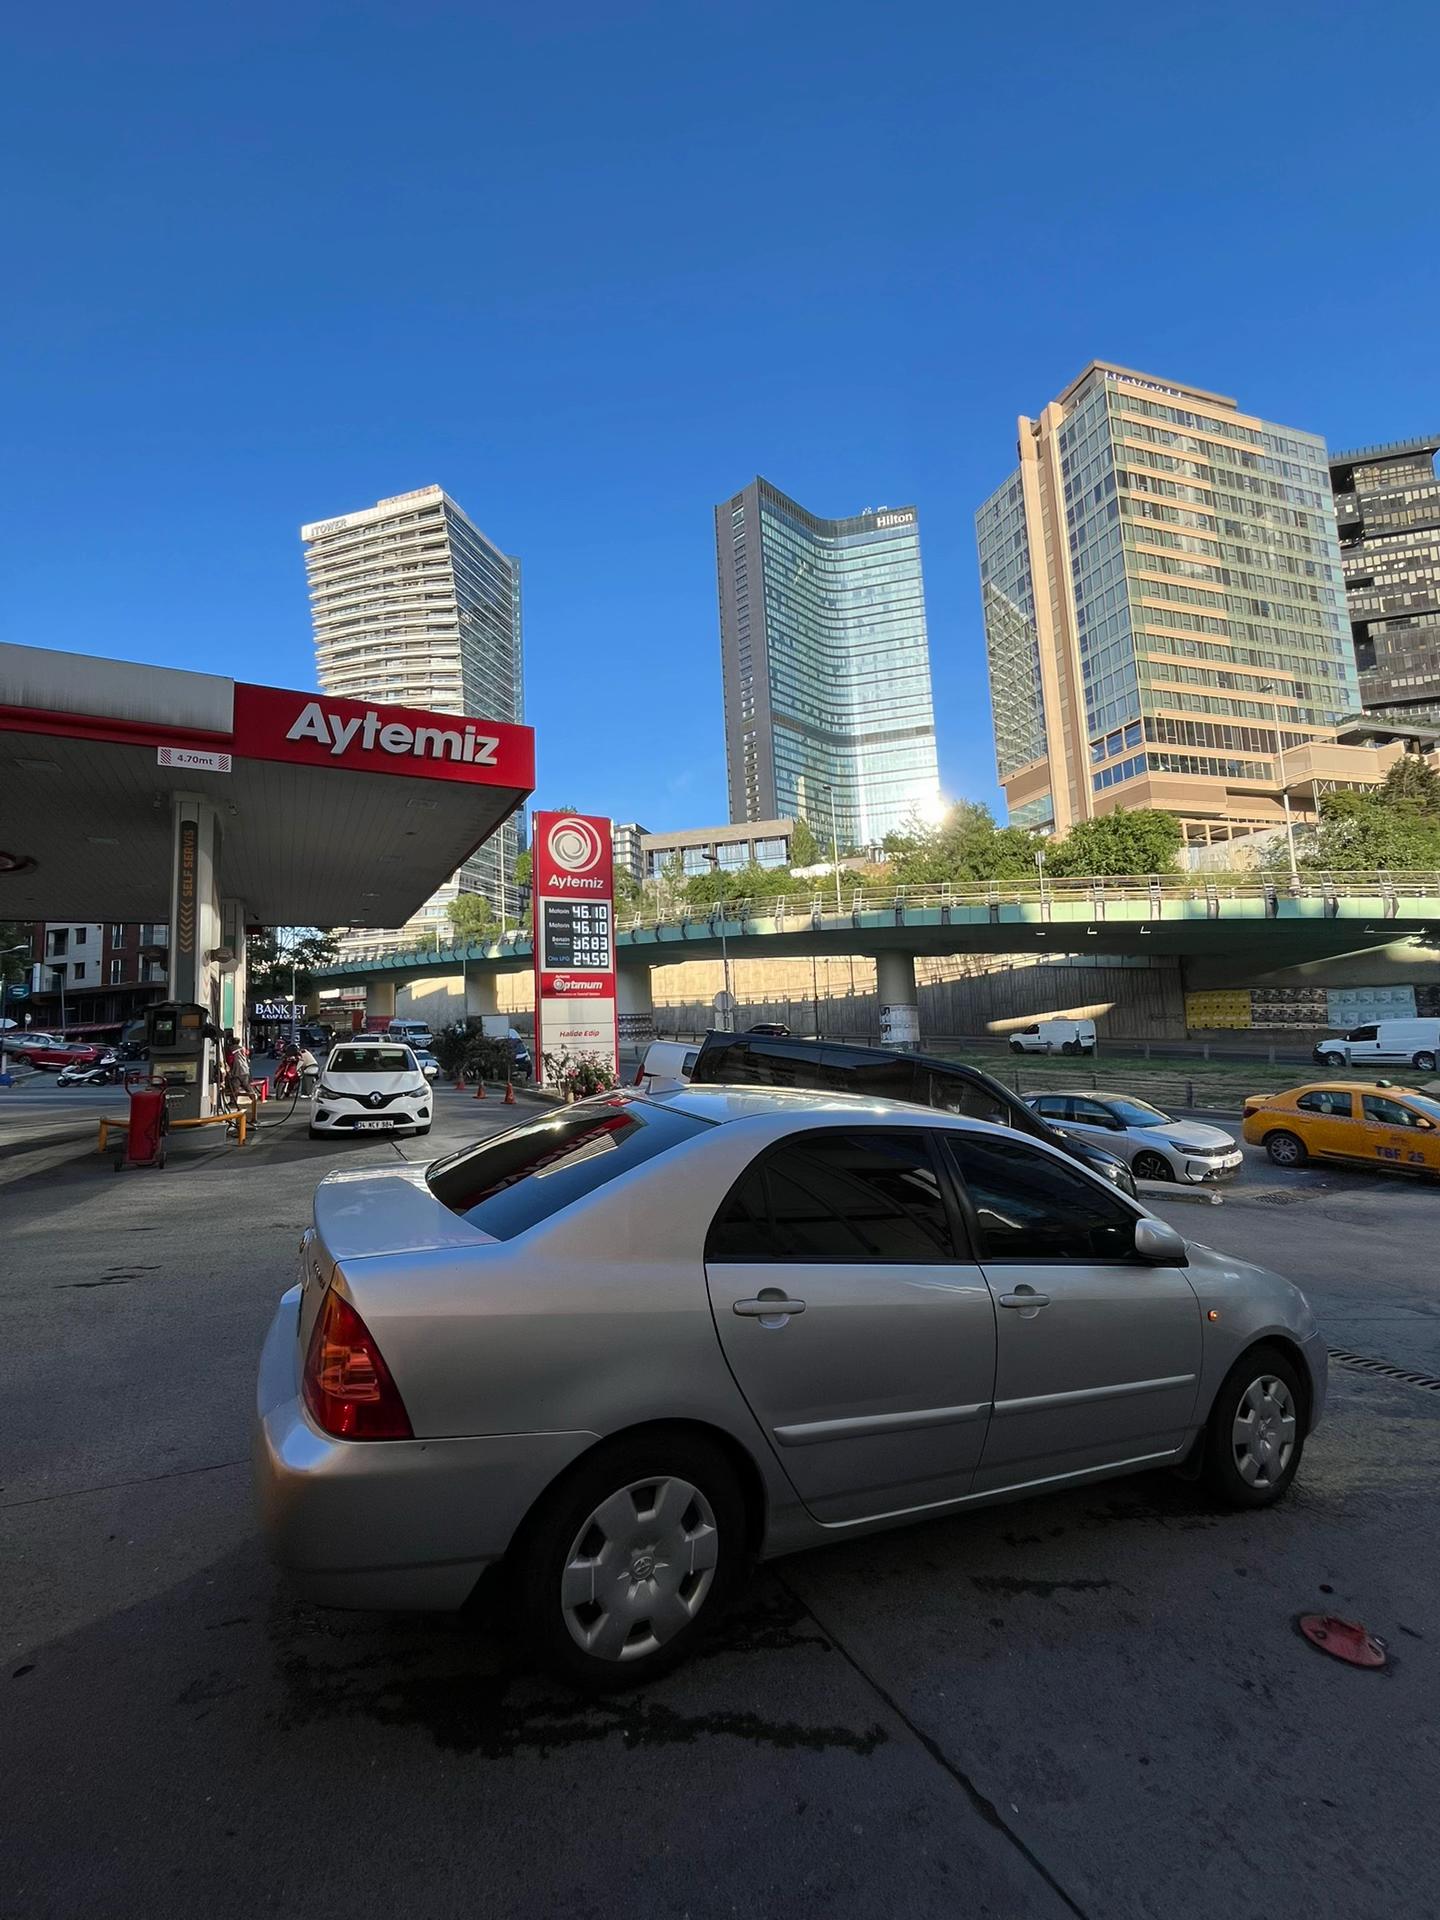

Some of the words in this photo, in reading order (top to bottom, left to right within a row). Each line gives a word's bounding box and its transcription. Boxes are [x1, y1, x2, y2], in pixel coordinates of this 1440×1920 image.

[877, 512, 913, 528] Hilton
[286, 702, 500, 766] Aytemiz
[177, 754, 214, 765] 4.70mt
[182, 870, 193, 897] SELF
[548, 874, 604, 889] Aytemiz
[572, 905, 607, 920] 46.10
[572, 921, 608, 935] 46.10
[573, 952, 609, 966] 24.59
